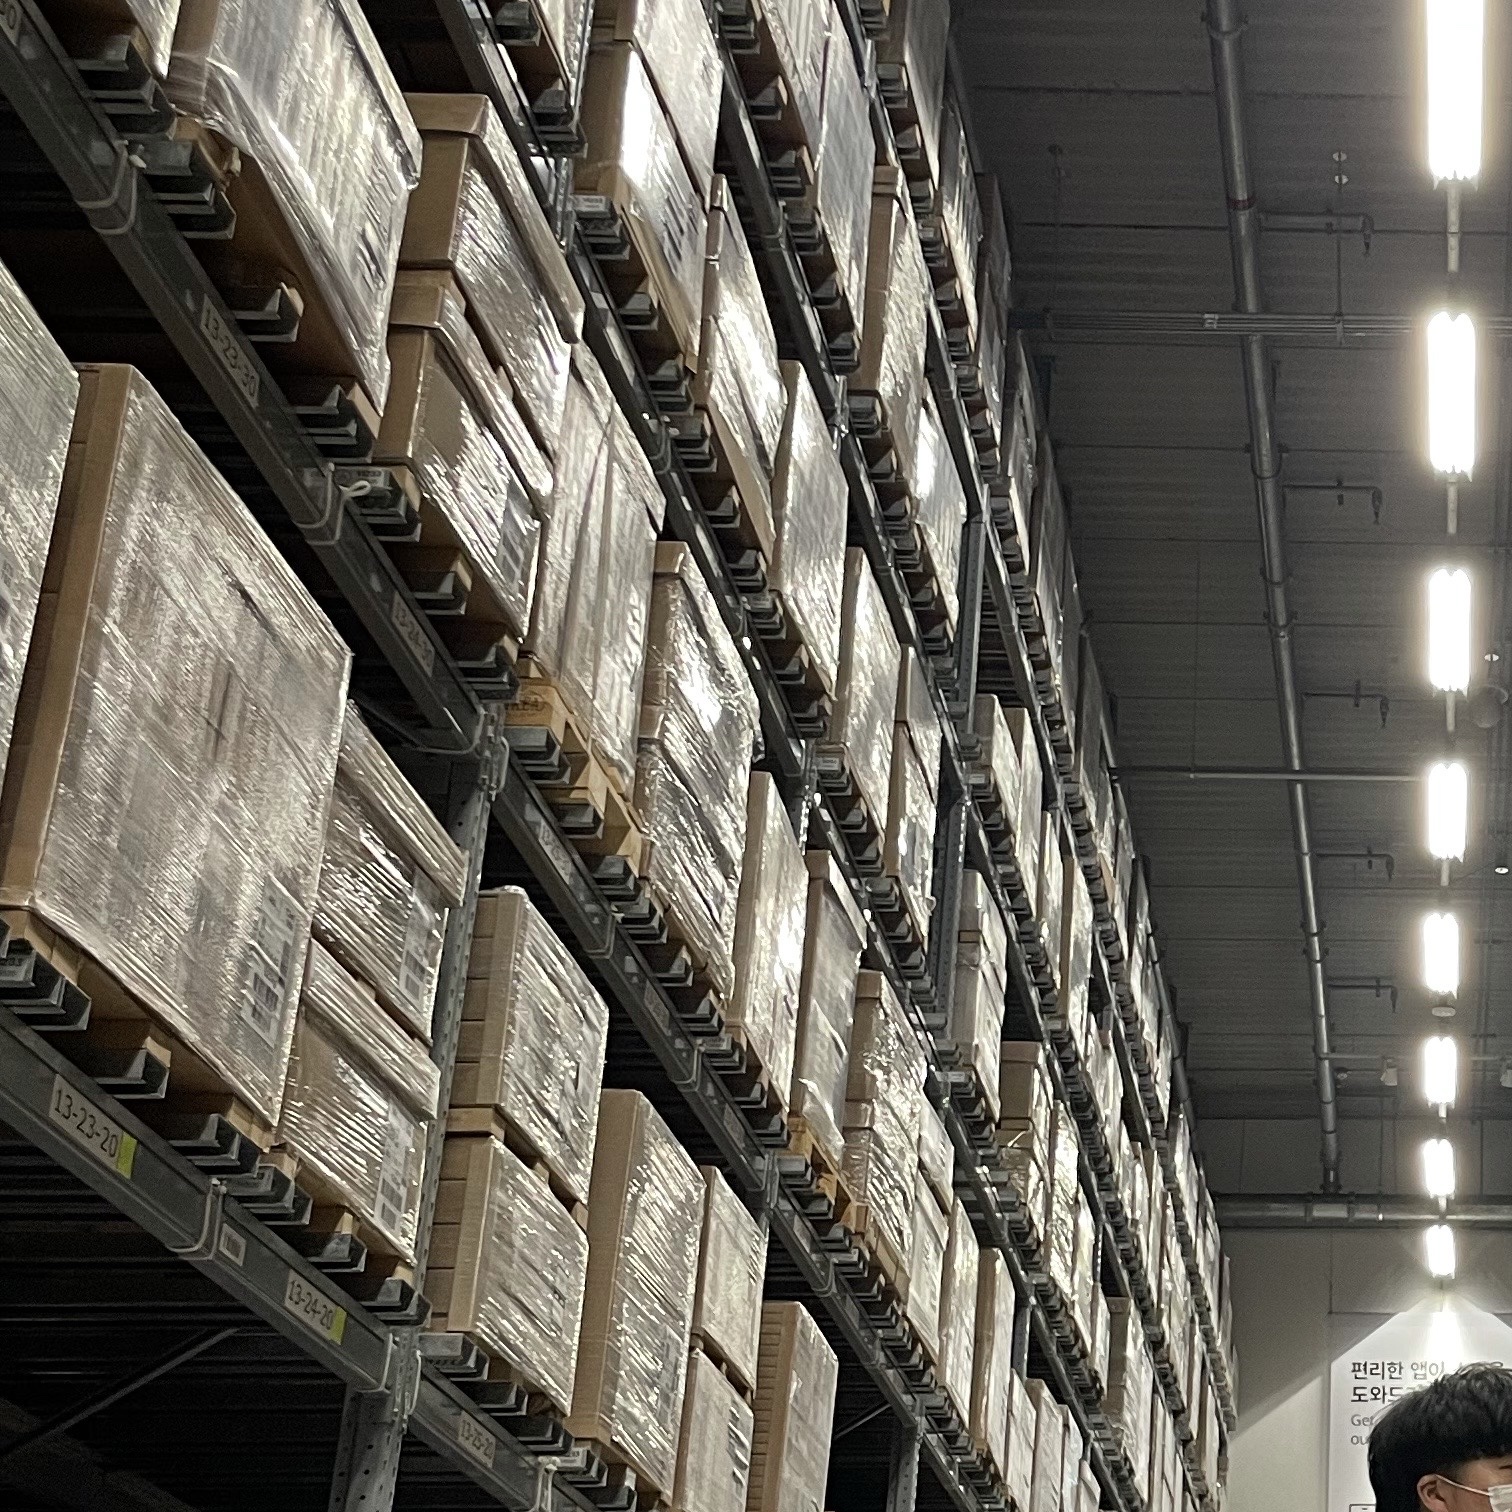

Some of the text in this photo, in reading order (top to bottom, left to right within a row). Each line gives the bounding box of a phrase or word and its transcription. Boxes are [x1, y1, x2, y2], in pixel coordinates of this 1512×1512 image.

[55, 1089, 119, 1158] 13-23-20
[288, 1280, 334, 1331] 13-24-20
[1351, 1361, 1444, 1380] 편리한 앱이
